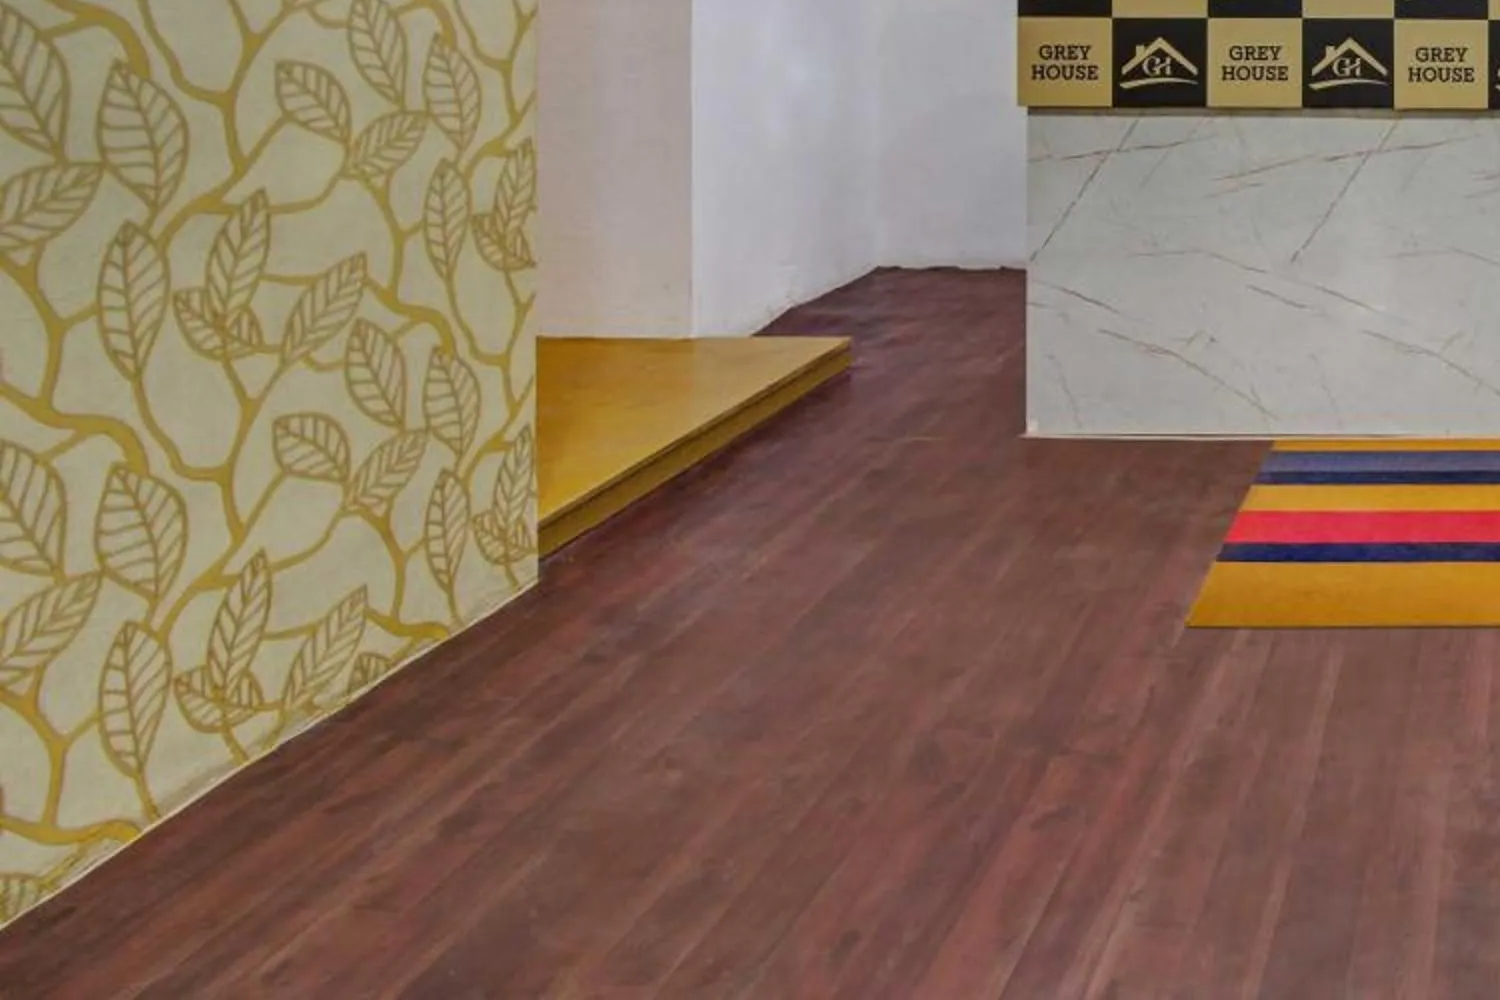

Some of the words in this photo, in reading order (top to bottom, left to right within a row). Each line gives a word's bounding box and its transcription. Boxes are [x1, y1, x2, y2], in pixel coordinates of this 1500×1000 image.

[1038, 44, 1092, 60] GREY
[1228, 45, 1282, 61] GREY
[1414, 47, 1469, 63] GREY
[1031, 65, 1099, 81] HOUSE
[1221, 65, 1289, 81] HOUSE
[1407, 67, 1475, 83] HOUSE
